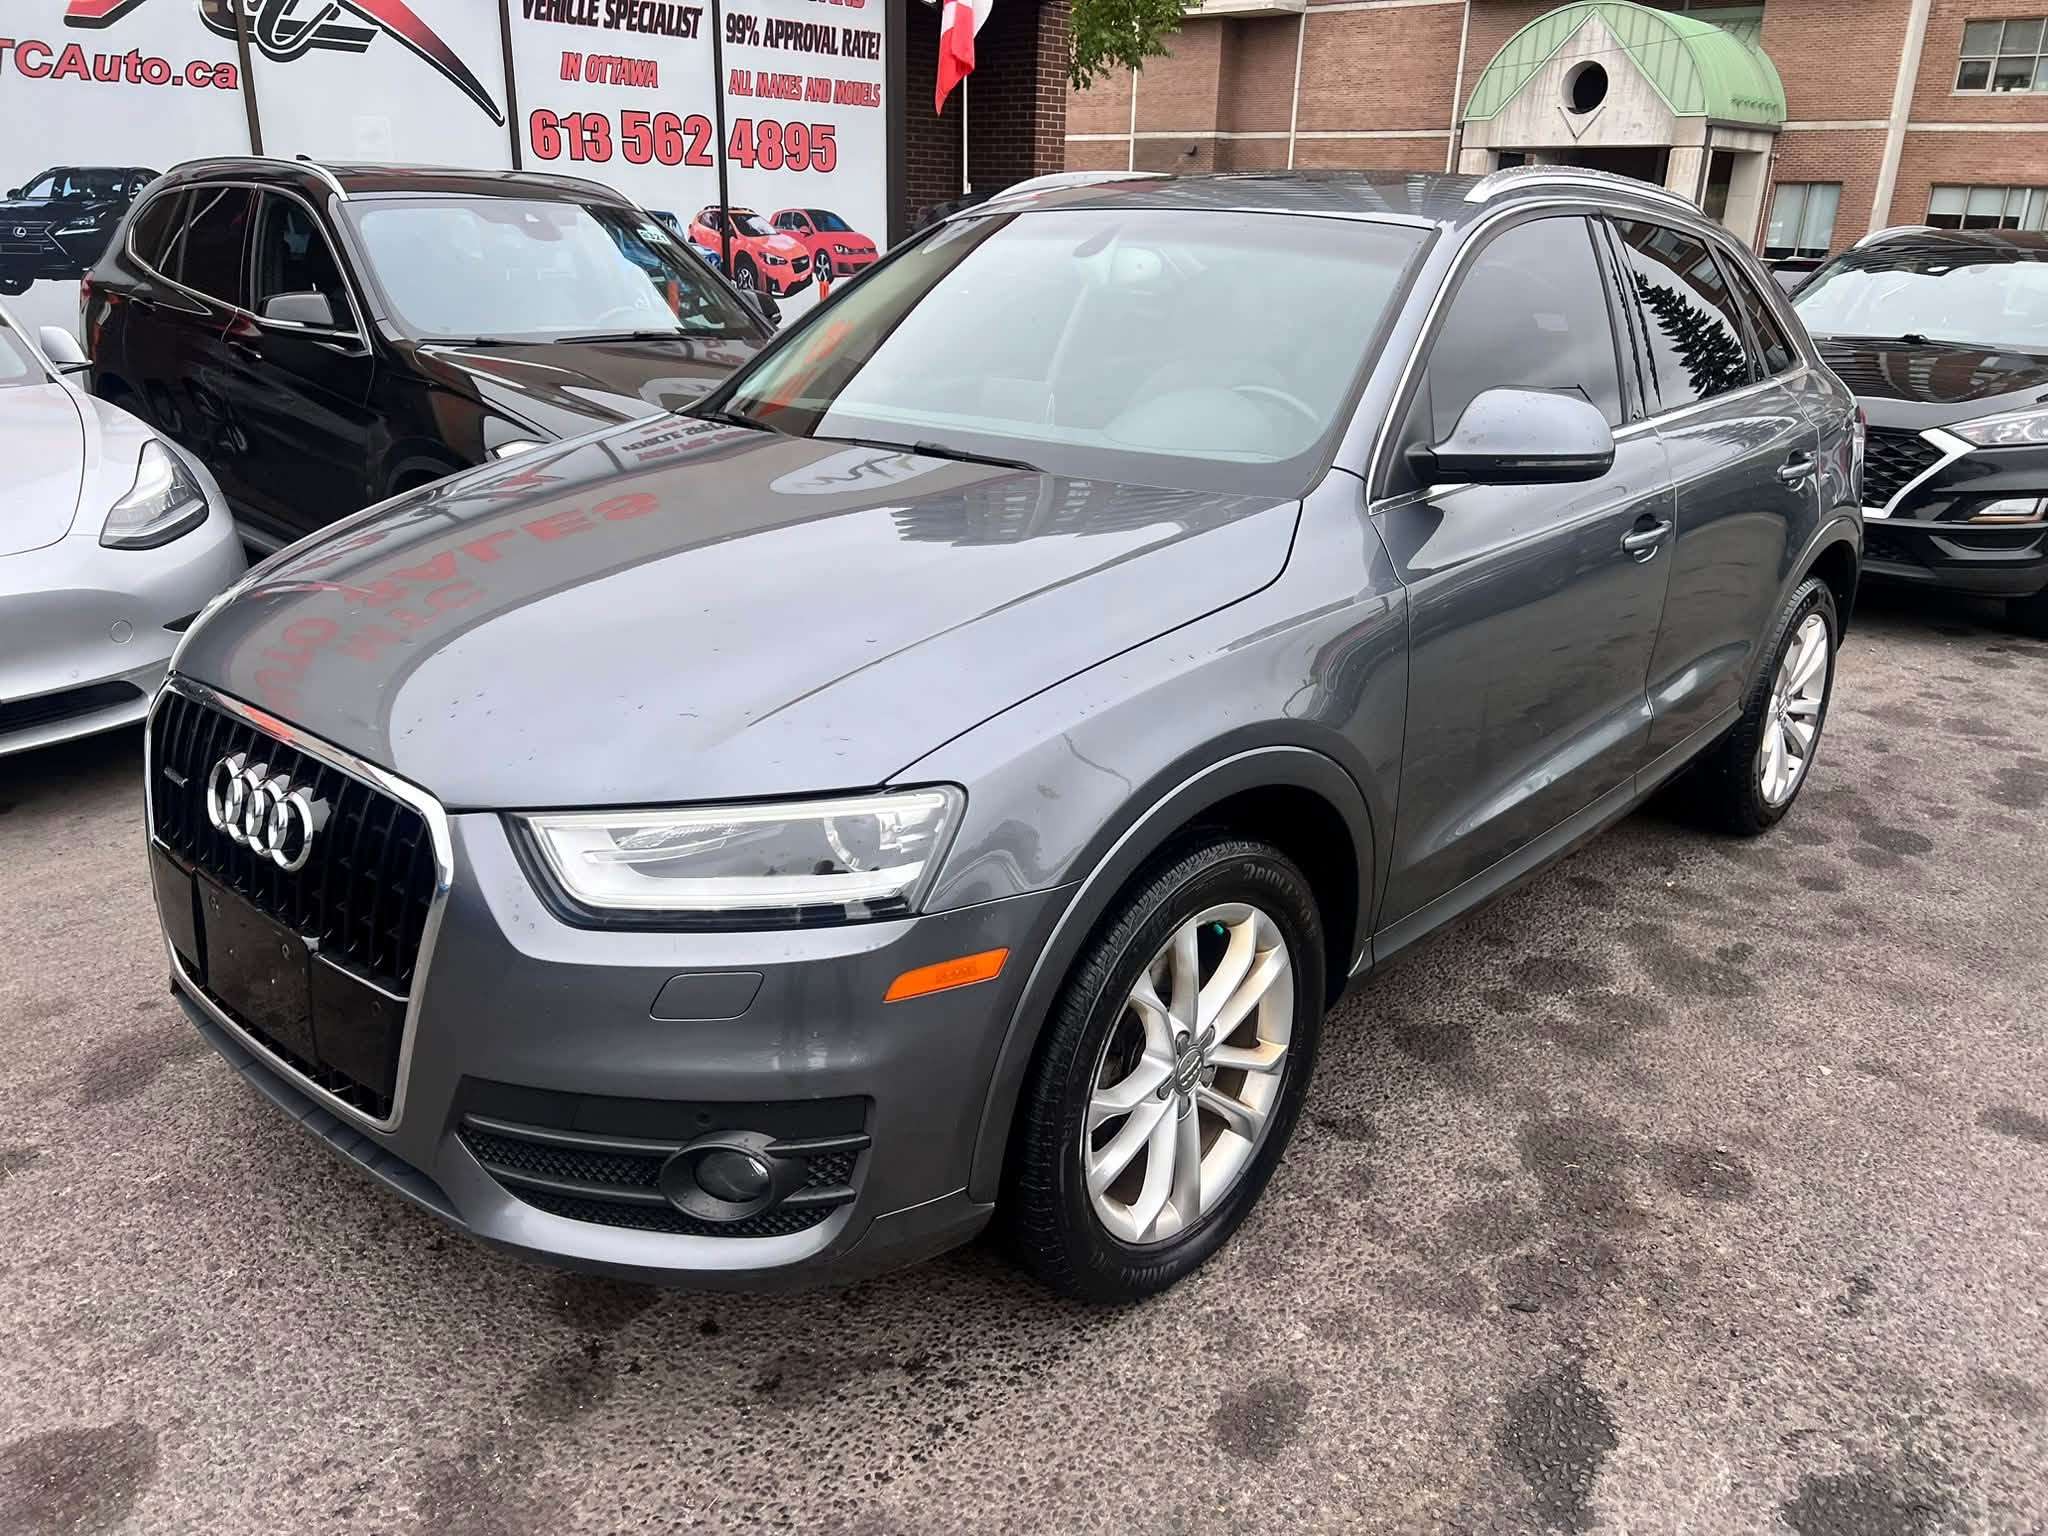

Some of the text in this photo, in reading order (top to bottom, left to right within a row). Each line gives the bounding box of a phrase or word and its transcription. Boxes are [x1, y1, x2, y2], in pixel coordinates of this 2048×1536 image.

[522, 0, 703, 39] VEHICLE SPECIALIST
[726, 13, 881, 60] 99% APPROVAL RATE!
[560, 51, 658, 88] IN OTTAWA
[728, 69, 881, 107] ALL MAKES AND MODELS
[530, 109, 837, 172] 613 562 4895
